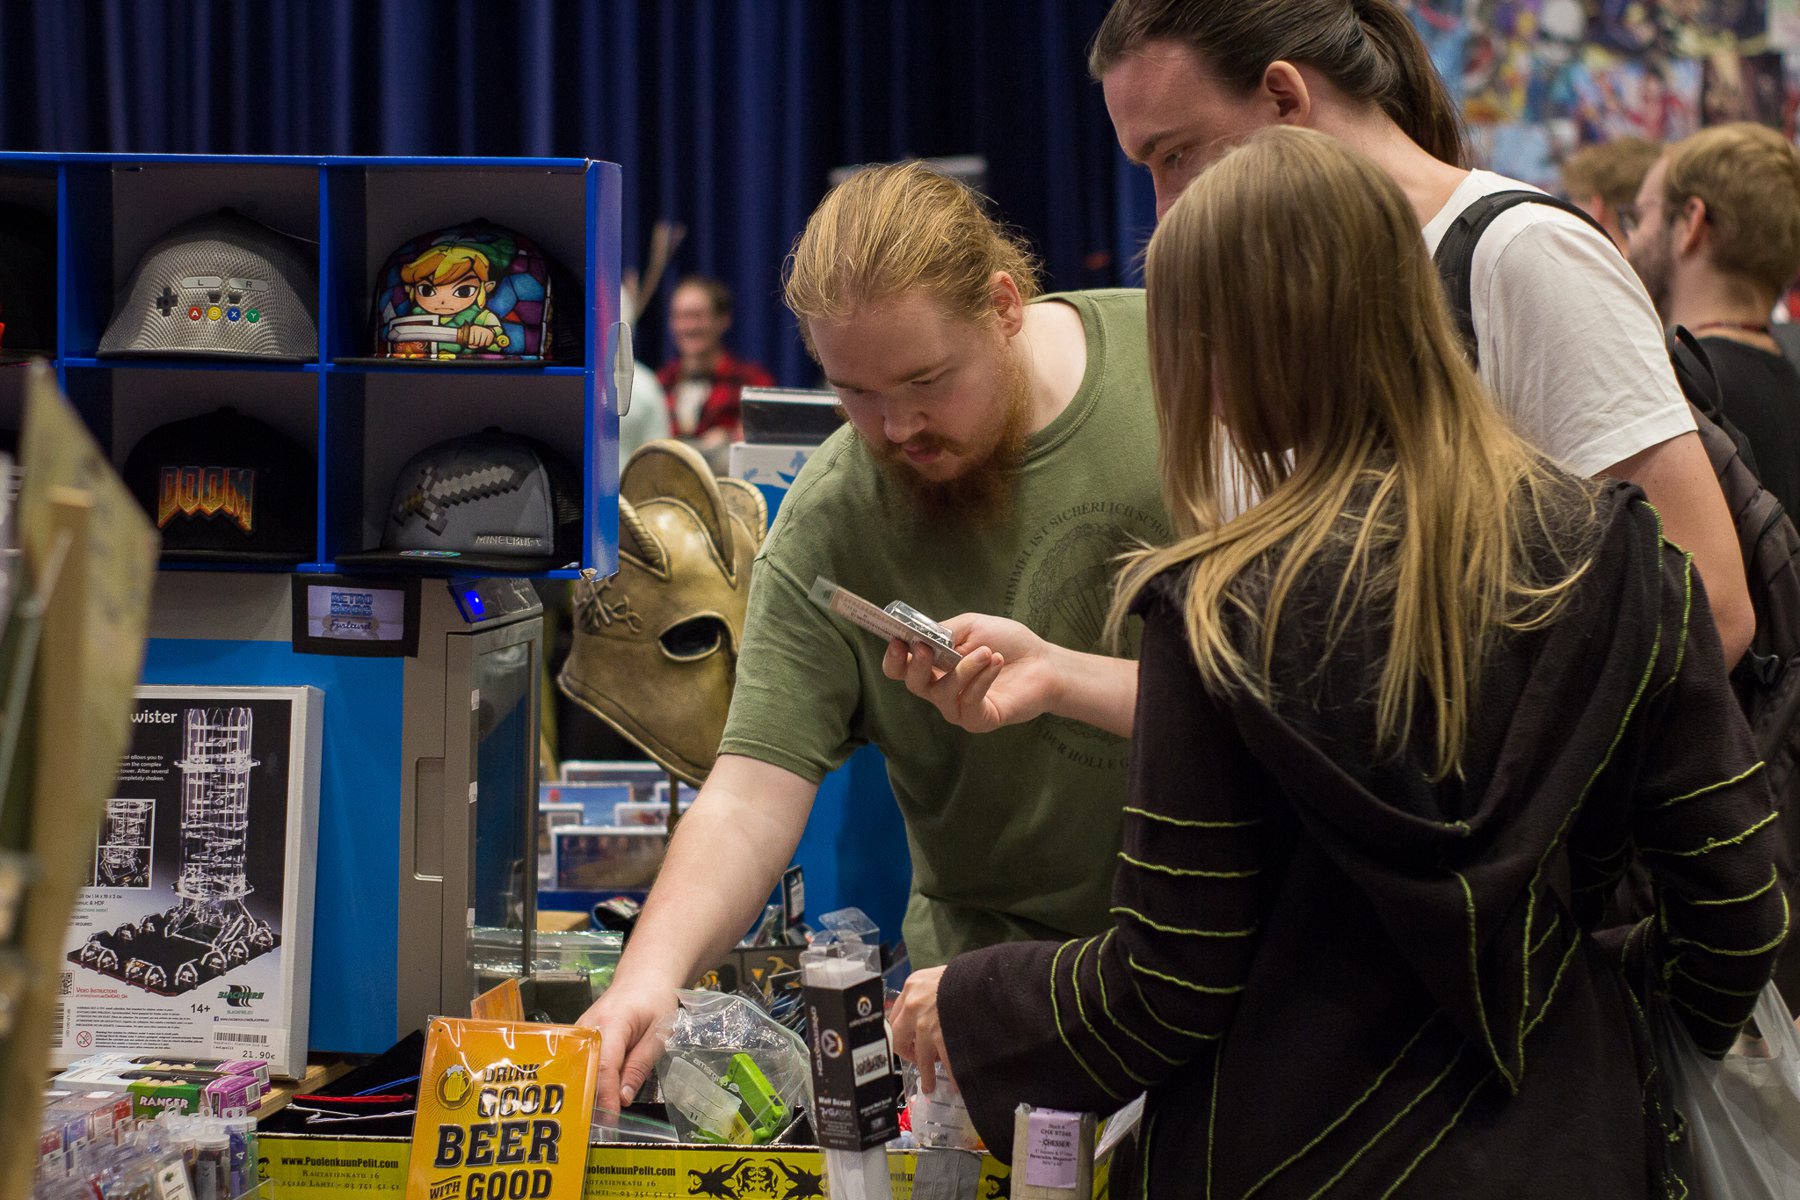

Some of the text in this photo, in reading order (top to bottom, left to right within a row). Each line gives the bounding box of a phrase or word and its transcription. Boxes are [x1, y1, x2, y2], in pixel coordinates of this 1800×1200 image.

[197, 279, 204, 287] L
[245, 281, 253, 289] R
[191, 309, 199, 317] A
[211, 309, 219, 317] B
[158, 466, 255, 532] DOOM
[475, 535, 542, 547] MINECRAFT
[1030, 524, 1050, 547] IST
[130, 709, 178, 724] wister
[190, 1003, 211, 1014] 14+
[242, 1050, 276, 1060] 21.90€
[484, 1064, 541, 1083] DRINK
[139, 1095, 189, 1109] RANGER
[477, 1083, 565, 1118] GOOD
[433, 1119, 561, 1168] BEER
[281, 1156, 399, 1169] www.PuolenkuunPelit.com
[370, 1170, 380, 1179] 16
[586, 1164, 676, 1177] uolenkuunPelit.com
[429, 1169, 553, 1200] WITH GOOD
[585, 1179, 643, 1187] AUTATIENKATU
